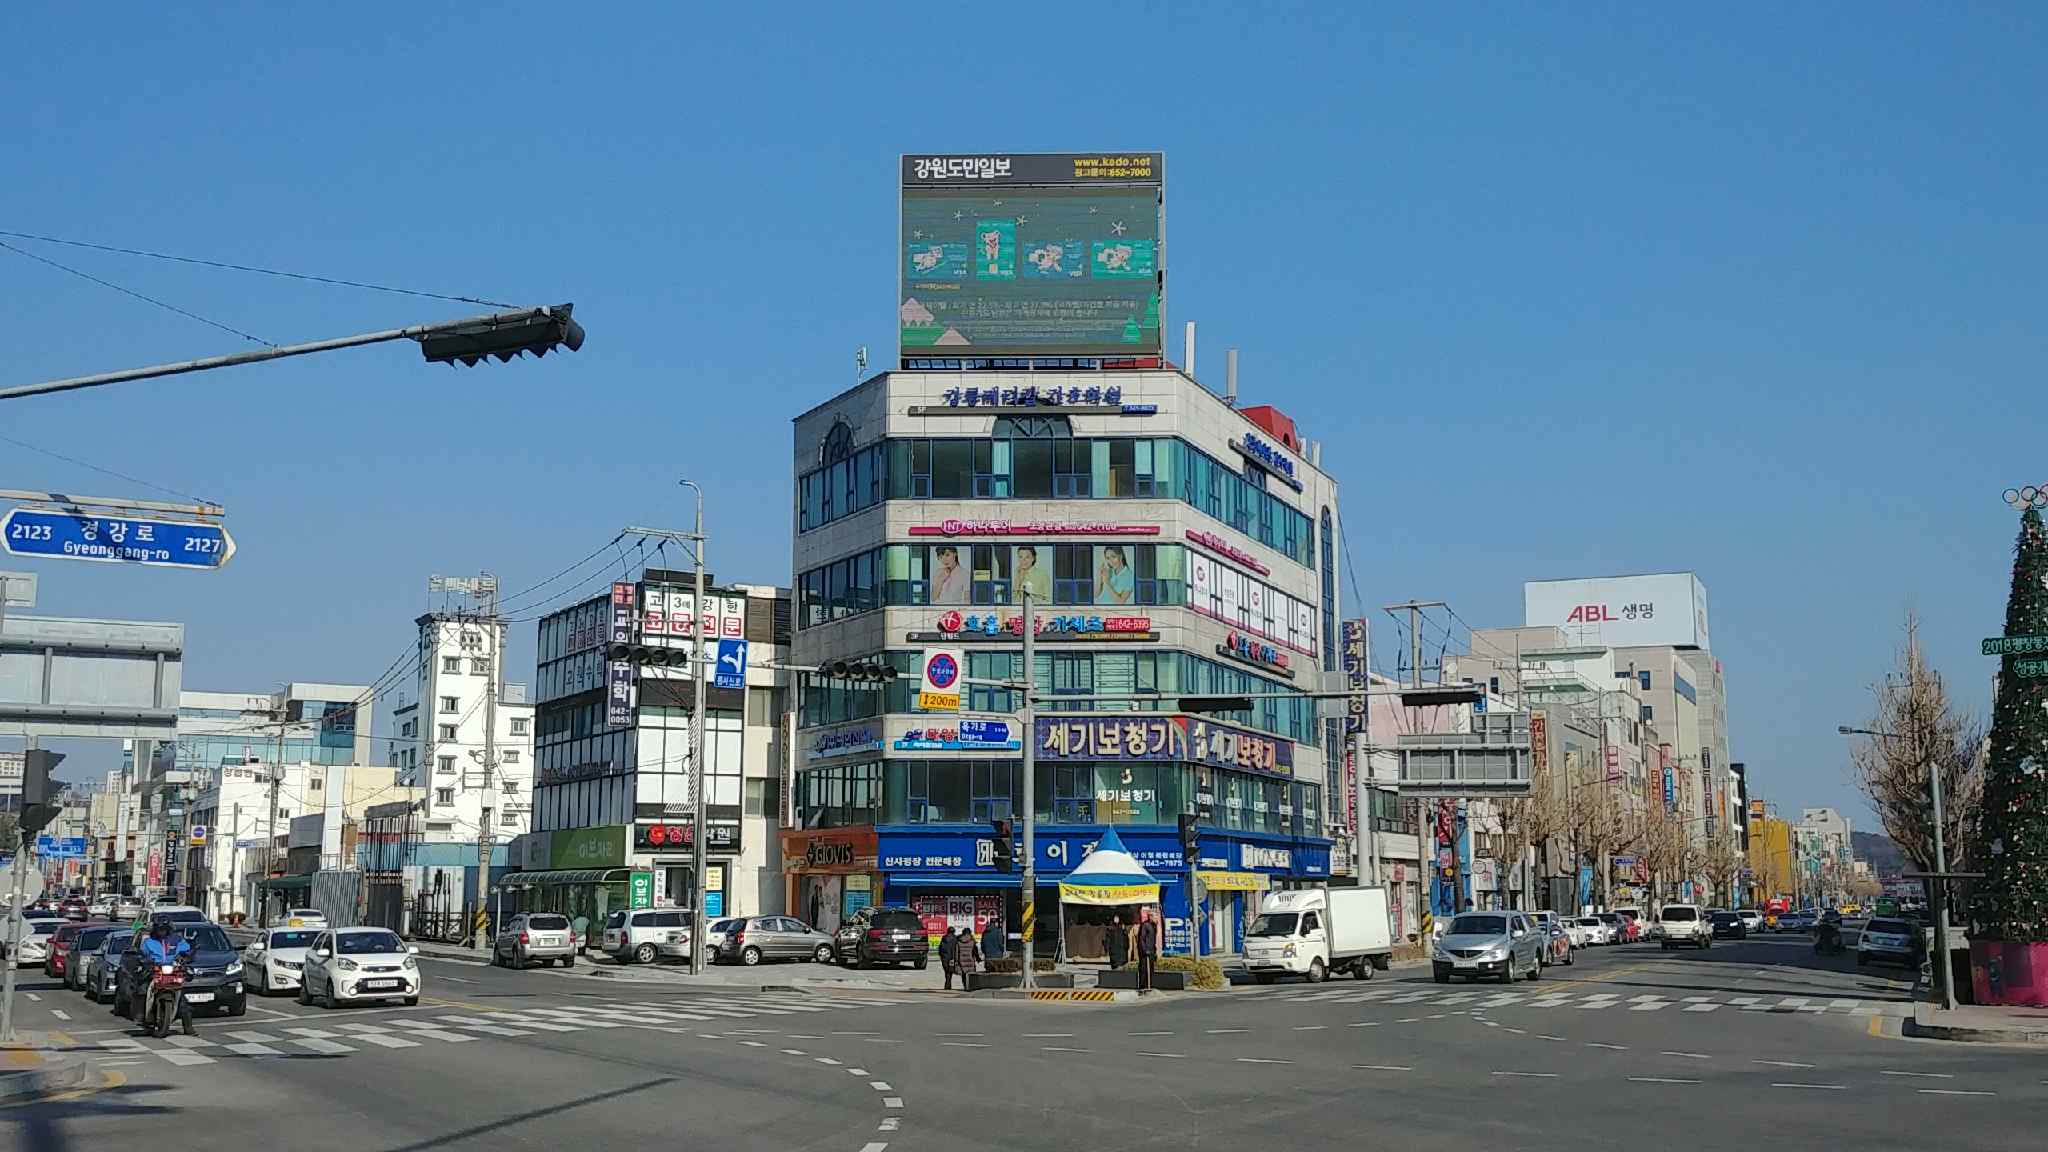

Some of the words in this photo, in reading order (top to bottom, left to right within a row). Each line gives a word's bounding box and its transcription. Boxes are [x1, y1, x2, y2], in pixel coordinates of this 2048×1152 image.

[914, 158, 1012, 178] 강원도민일보
[11, 524, 52, 541] 2123
[80, 520, 154, 543] 경강로
[184, 536, 221, 553] 2127
[63, 540, 170, 561] Gyeonggang-ro
[1566, 604, 1619, 624] ABL
[1622, 602, 1655, 620] 생명
[930, 695, 957, 707] 200m
[949, 901, 973, 914] BIG
